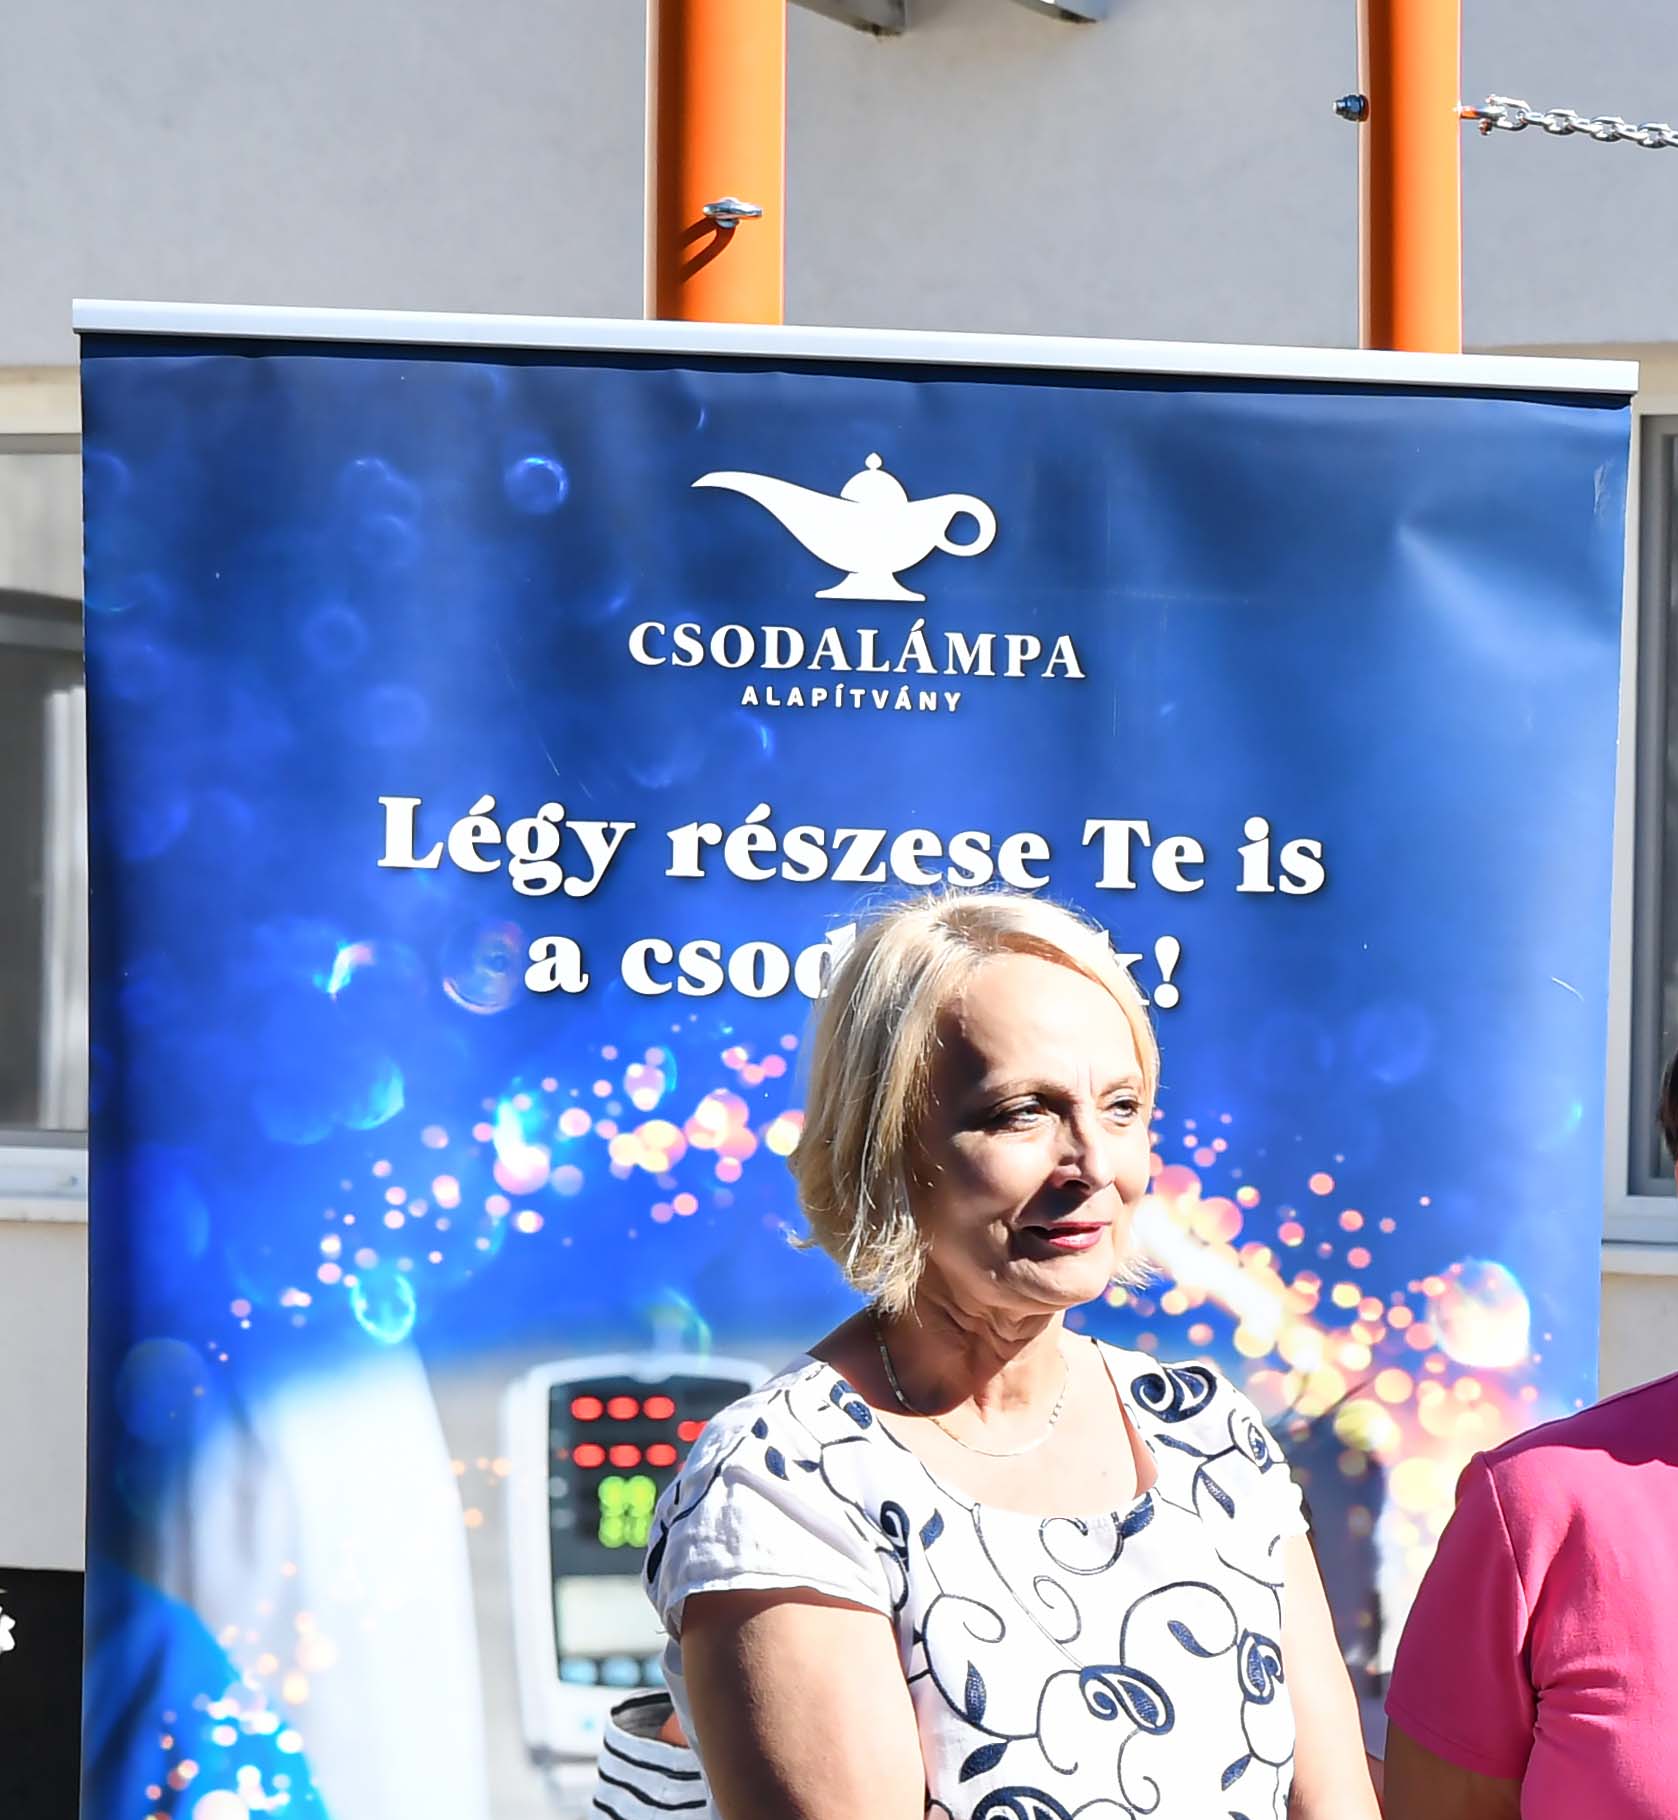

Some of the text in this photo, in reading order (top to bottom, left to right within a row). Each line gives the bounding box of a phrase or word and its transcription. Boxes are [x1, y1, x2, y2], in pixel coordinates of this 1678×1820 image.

[628, 618, 1086, 679] CSODALÁMPA
[741, 682, 961, 712] ALAPÍTVÁNY
[376, 794, 1326, 897] Légy részese Te is
[524, 934, 590, 994] a
